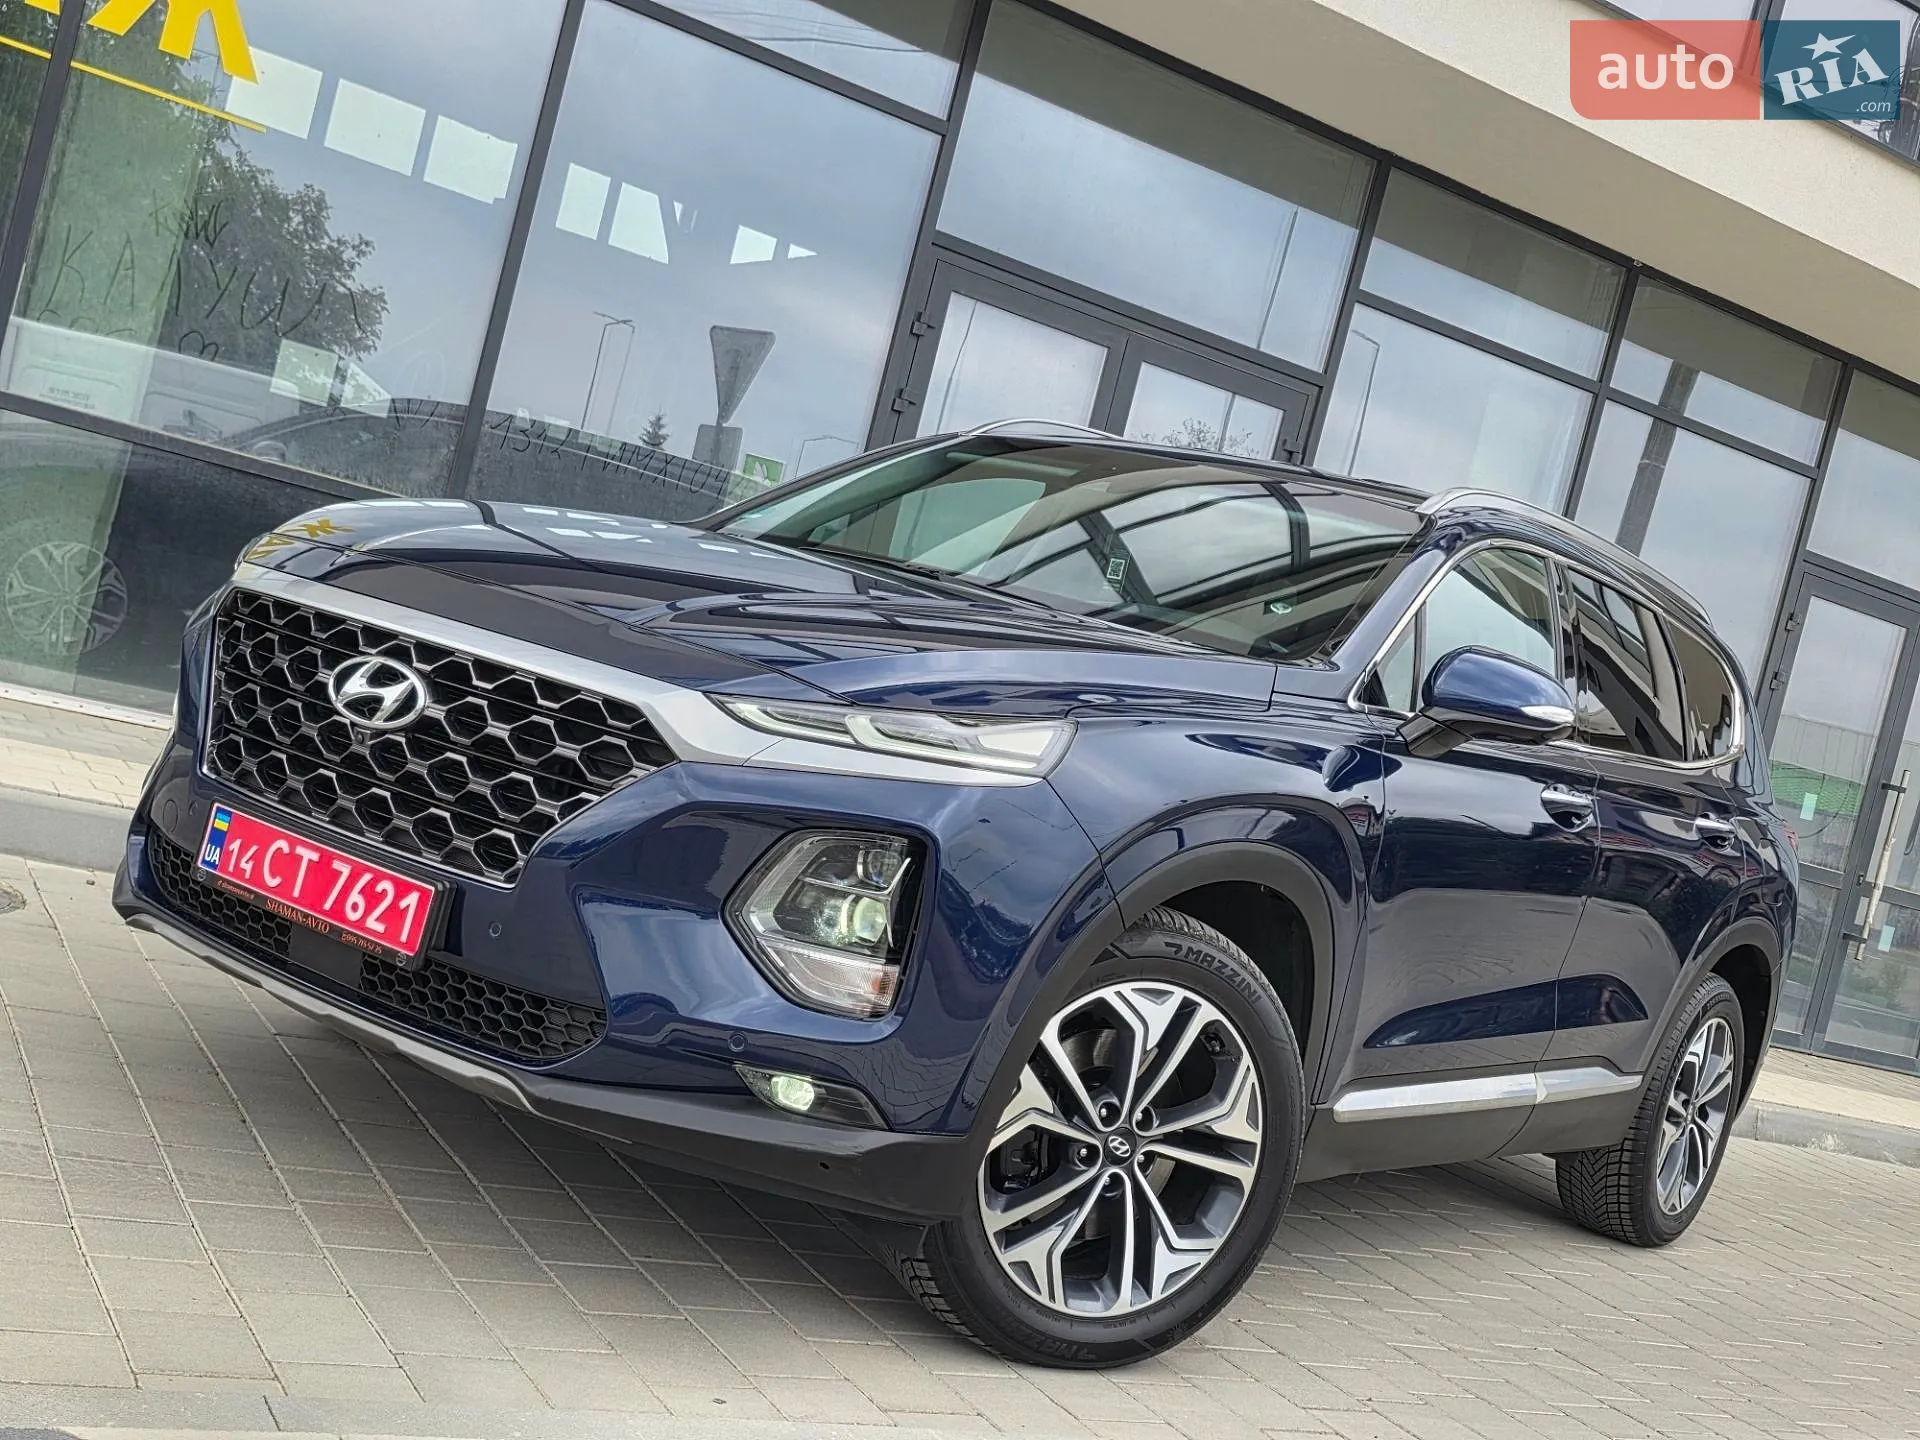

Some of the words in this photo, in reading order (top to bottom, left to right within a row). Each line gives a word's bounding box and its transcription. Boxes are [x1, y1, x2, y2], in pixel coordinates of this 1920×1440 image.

[204, 843, 221, 865] UA
[227, 838, 260, 880] 14
[263, 839, 320, 898] CT
[322, 859, 422, 944] 7621
[1183, 946, 1264, 1005] MAZZINI
